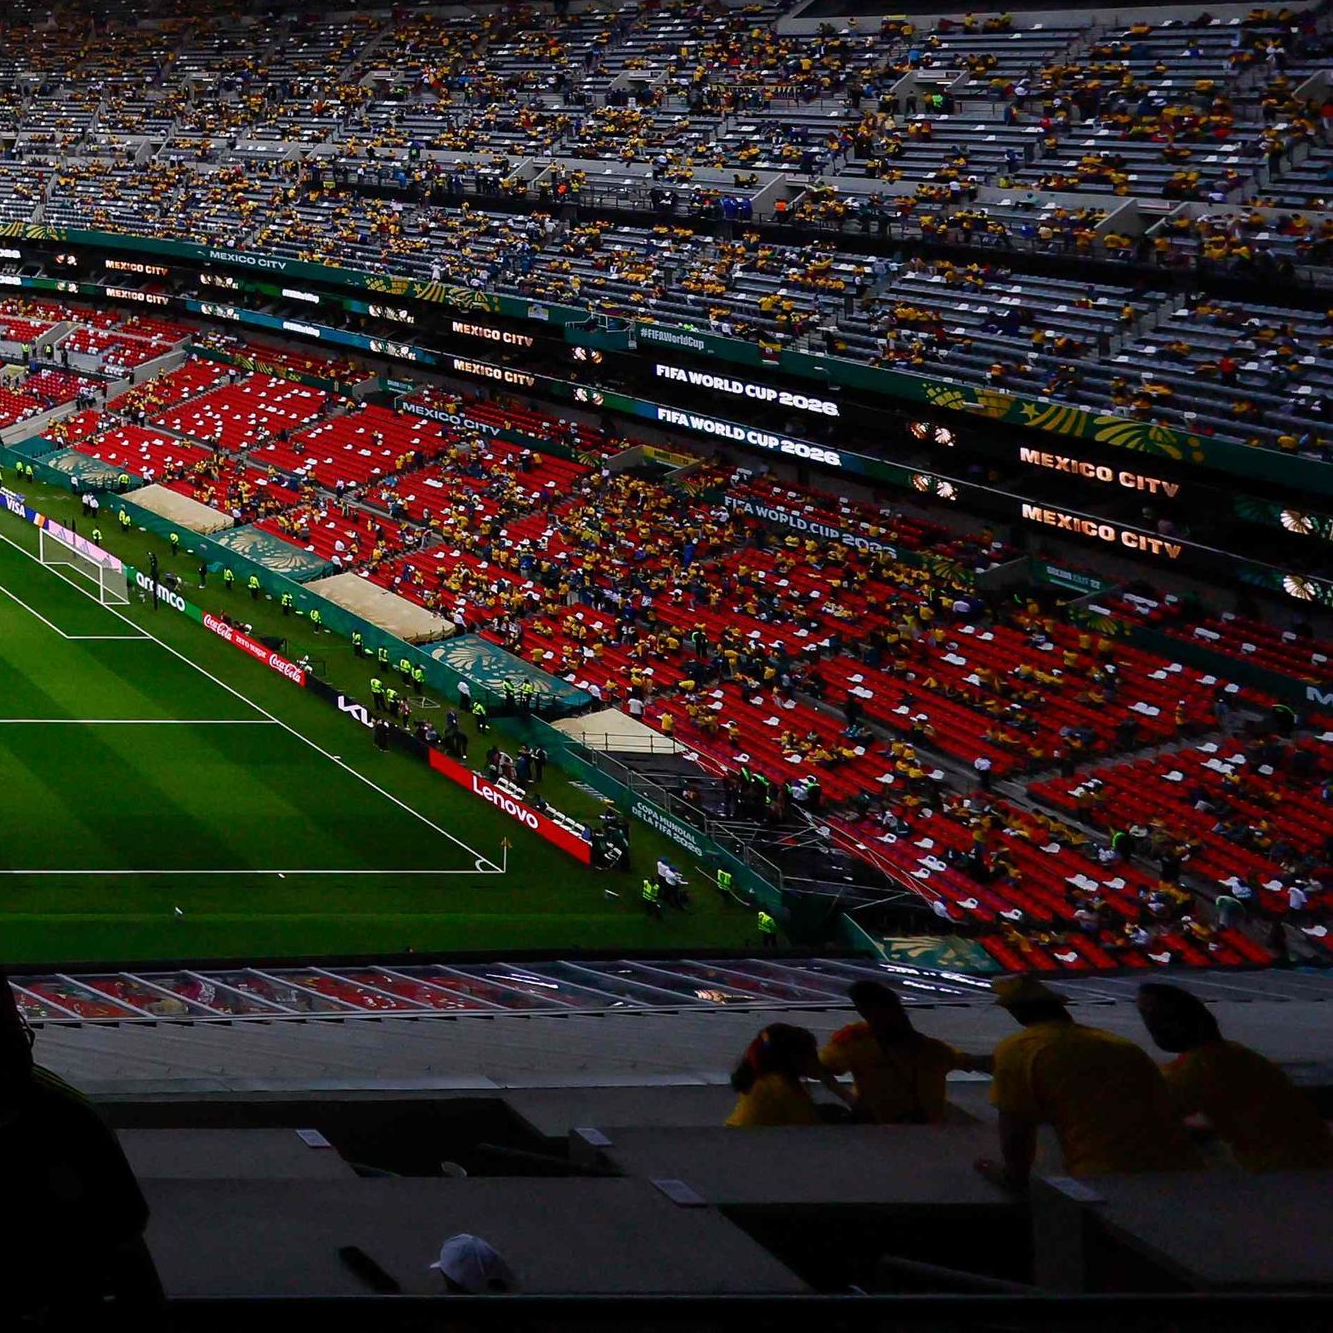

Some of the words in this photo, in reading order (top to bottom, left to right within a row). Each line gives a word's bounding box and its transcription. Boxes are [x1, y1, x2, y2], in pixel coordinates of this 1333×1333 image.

[105, 260, 144, 274] MEXICO
[145, 264, 168, 276] CITY
[209, 250, 256, 266] MEXICO
[258, 258, 287, 270] CITY
[106, 288, 144, 303] MEXICO
[146, 292, 169, 305] CITY
[452, 321, 502, 342] MEXICO
[503, 332, 534, 348] CITY
[640, 327, 705, 350] #FIFAWorldCup
[453, 359, 503, 382] MEXICO
[504, 371, 535, 387] CITY
[656, 363, 688, 383] FIFA
[689, 372, 744, 395] WORLD
[745, 384, 777, 403] CUP
[778, 391, 837, 417] 2026
[402, 401, 460, 426] MEXICO
[463, 417, 501, 437] CITY
[657, 407, 689, 428] FIFA
[690, 416, 745, 442] WORLD
[746, 430, 779, 450] CUP
[780, 439, 839, 466] 2026
[1019, 447, 1114, 482] MEXICO
[1118, 470, 1180, 499] CITY
[5, 497, 26, 517] VISA
[756, 505, 807, 531] WORLD
[810, 522, 840, 539] CUP
[1021, 503, 1116, 542] MEXICO
[1120, 530, 1182, 560] CITY
[269, 653, 302, 683] Coca-Cola
[473, 774, 539, 830] Lenovo
[631, 806, 642, 818] DE
[643, 813, 653, 826] LA
[655, 820, 673, 837] FIFA
[673, 833, 703, 857] 2026
[637, 802, 659, 820] COPA
[659, 814, 697, 845] MUNDIAL
